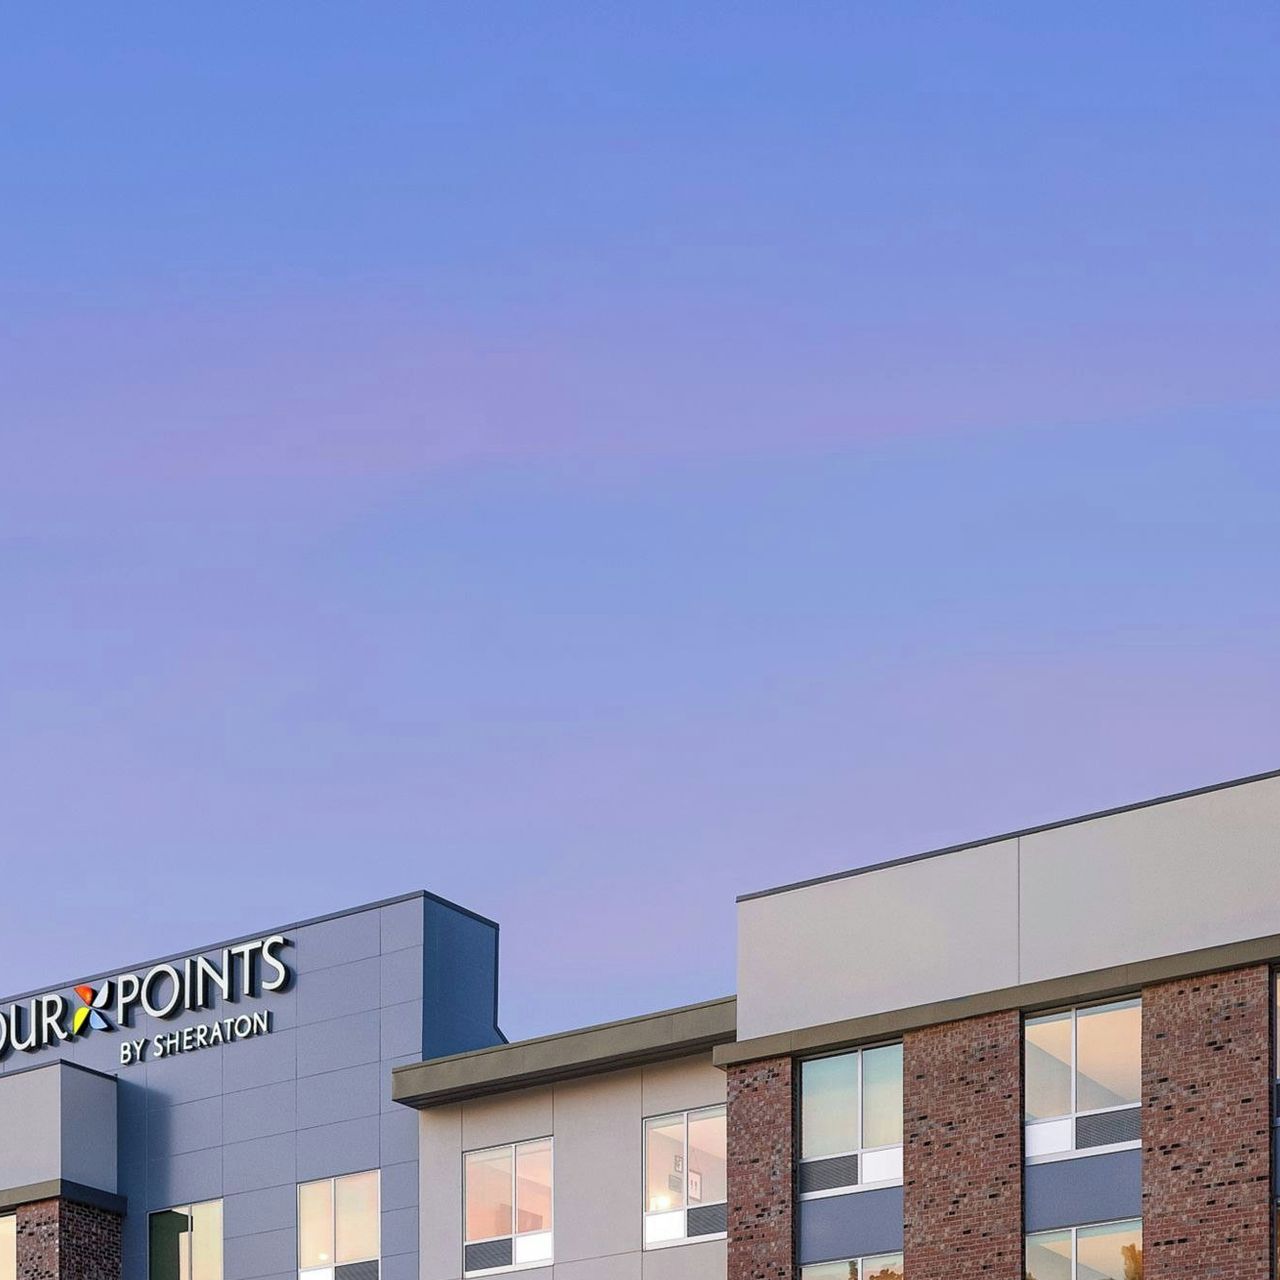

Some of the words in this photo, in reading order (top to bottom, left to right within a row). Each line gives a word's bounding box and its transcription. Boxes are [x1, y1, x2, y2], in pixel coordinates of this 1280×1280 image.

[117, 935, 286, 1025] POINTS
[120, 1038, 146, 1064] BY
[153, 1010, 269, 1058] SHERATON
